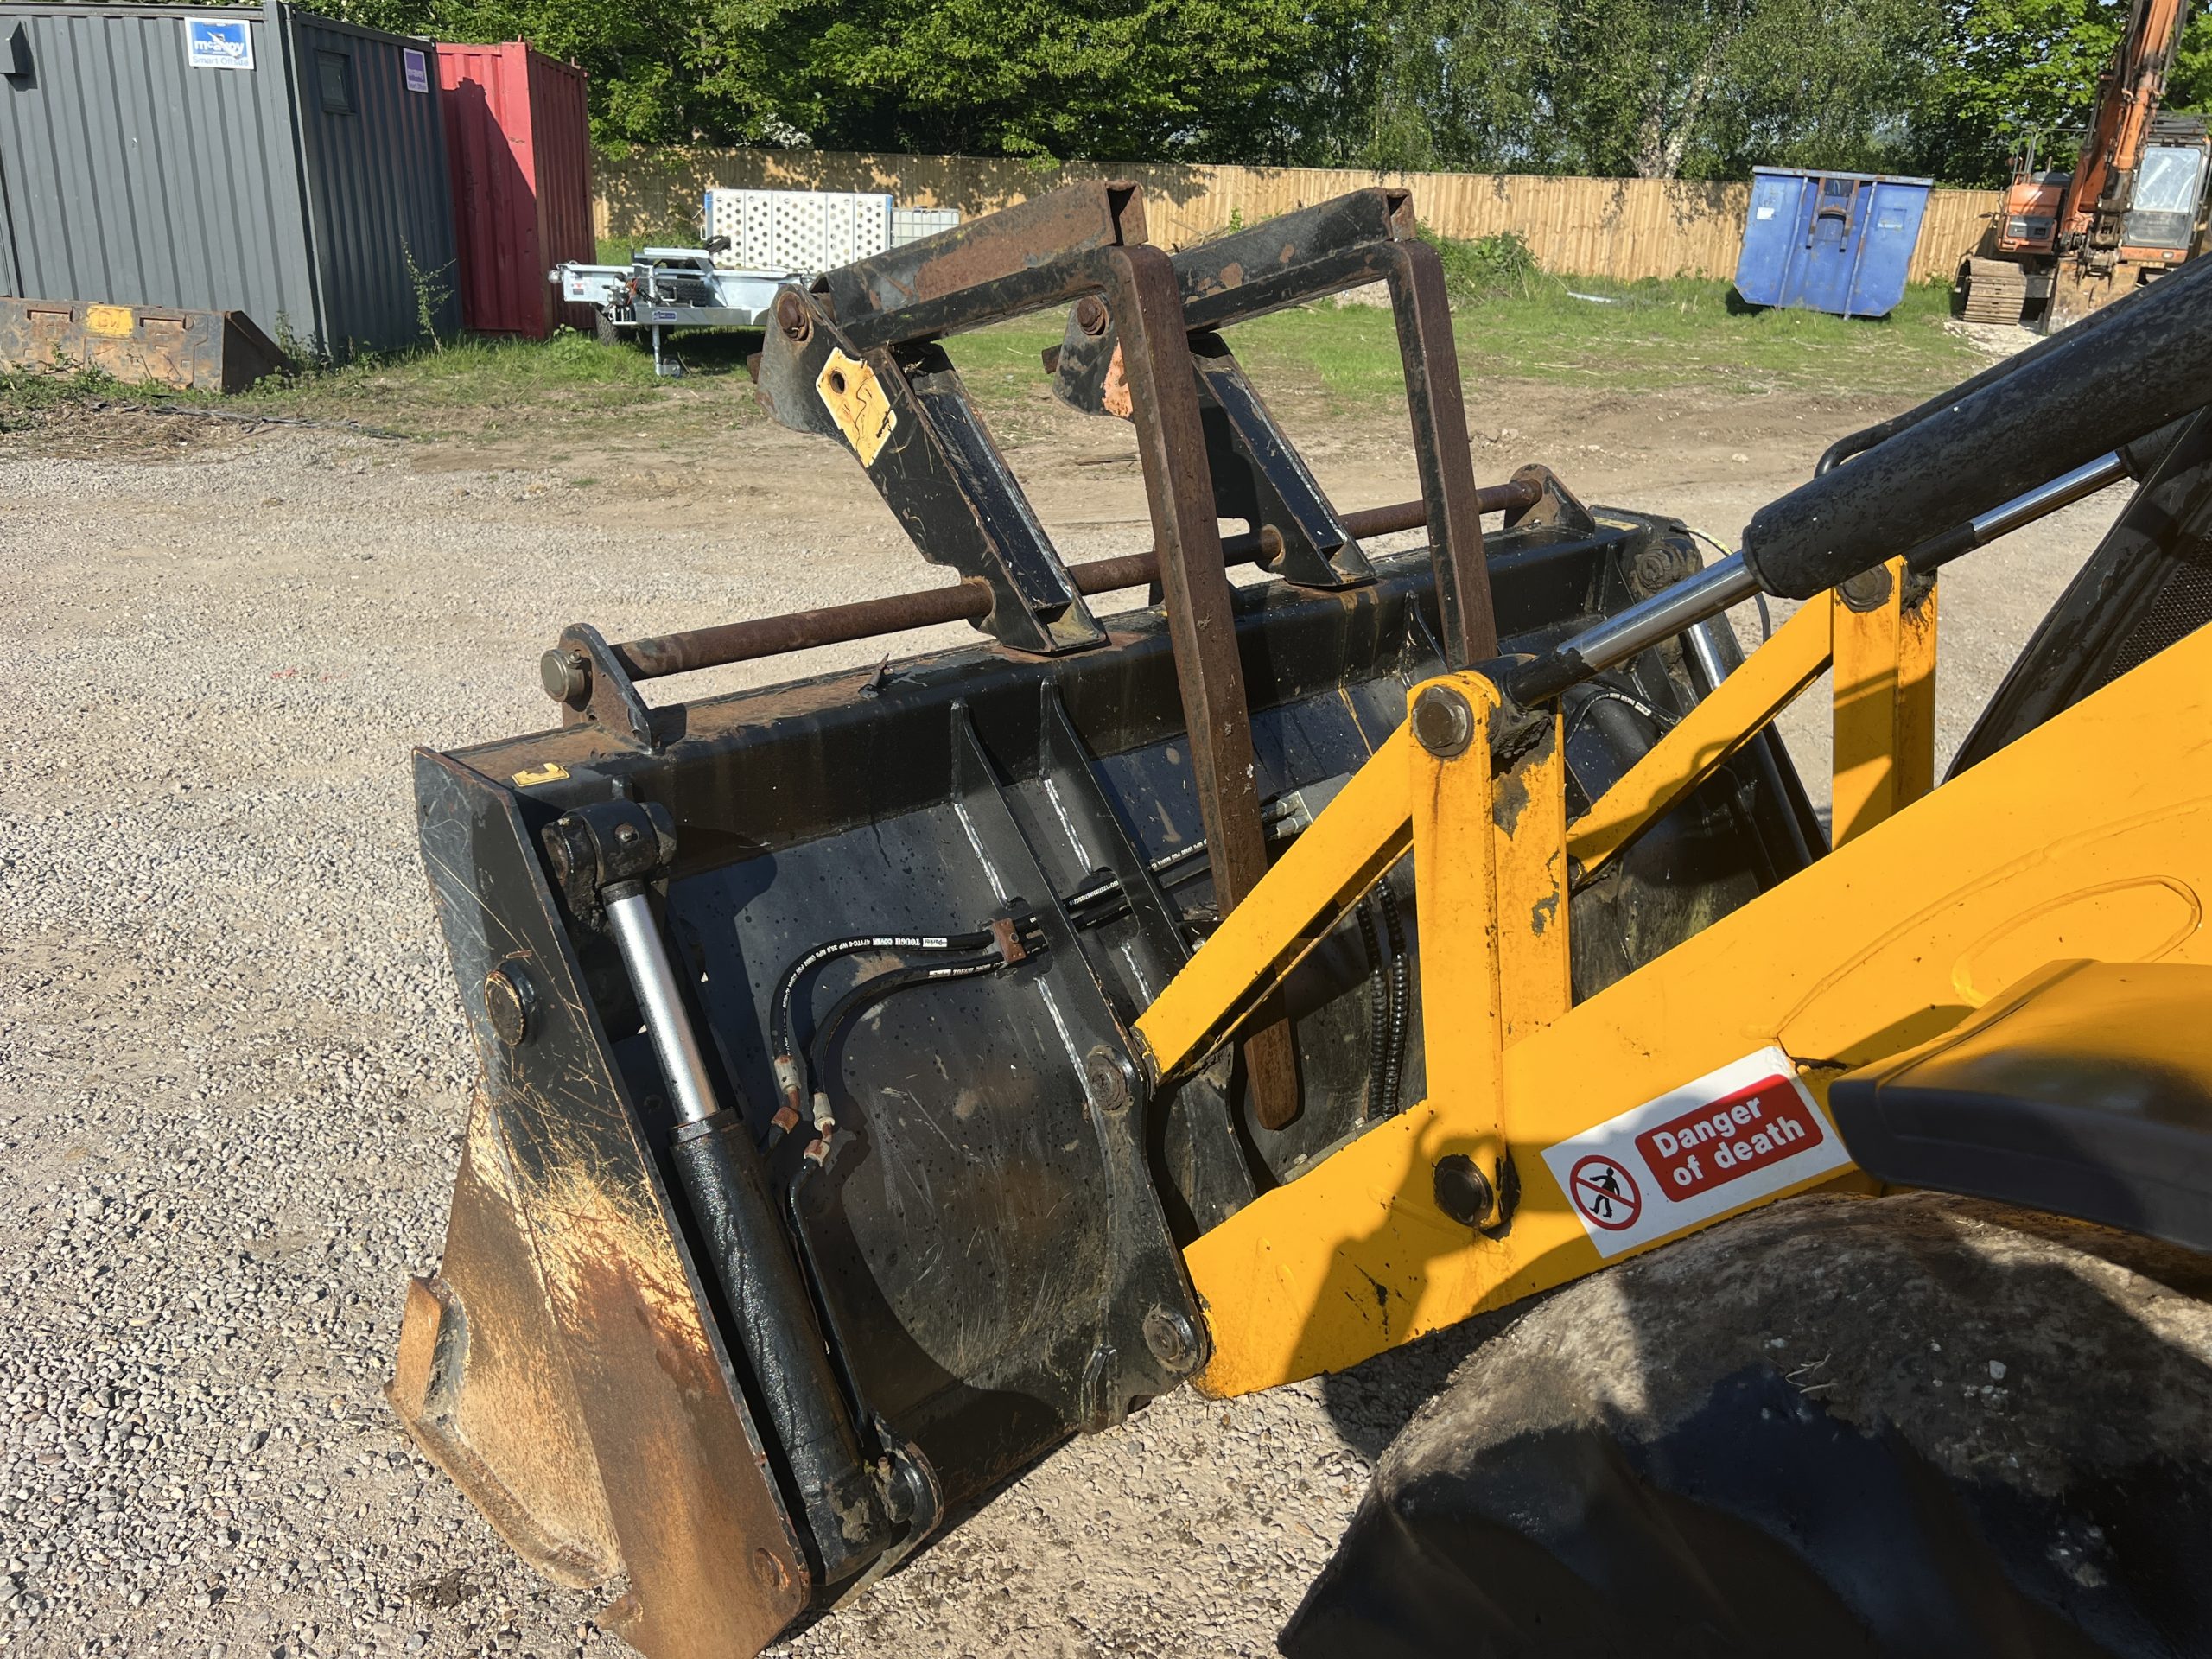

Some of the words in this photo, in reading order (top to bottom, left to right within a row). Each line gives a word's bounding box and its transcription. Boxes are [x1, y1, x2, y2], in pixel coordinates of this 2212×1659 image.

[924, 938, 945, 947] Parker
[1652, 1097, 1762, 1159] Danger
[1673, 1154, 1704, 1185] of
[1714, 1116, 1805, 1169] death
